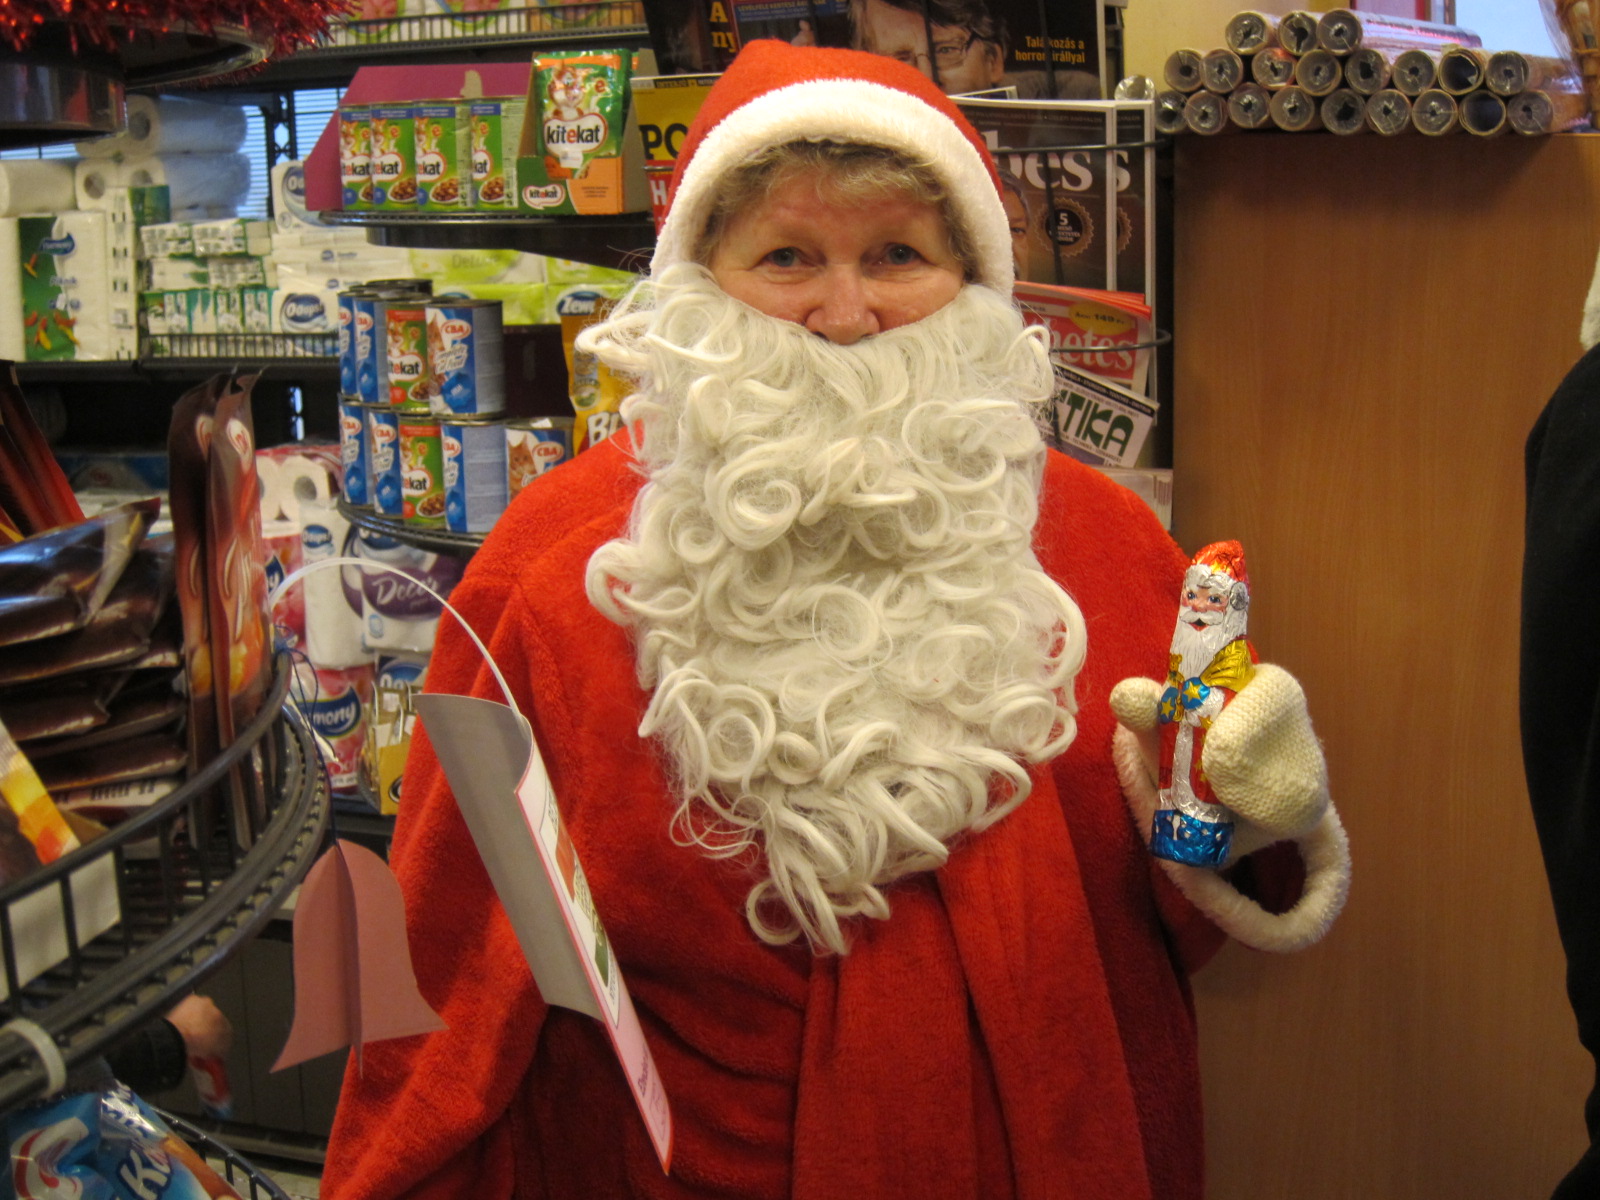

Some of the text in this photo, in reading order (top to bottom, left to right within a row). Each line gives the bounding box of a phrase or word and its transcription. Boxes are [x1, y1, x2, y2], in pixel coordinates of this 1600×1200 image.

[547, 125, 600, 143] kitekat
[529, 188, 558, 200] kitekat
[1060, 212, 1069, 226] 5
[444, 325, 467, 334] CBA
[536, 444, 560, 456] CBA
